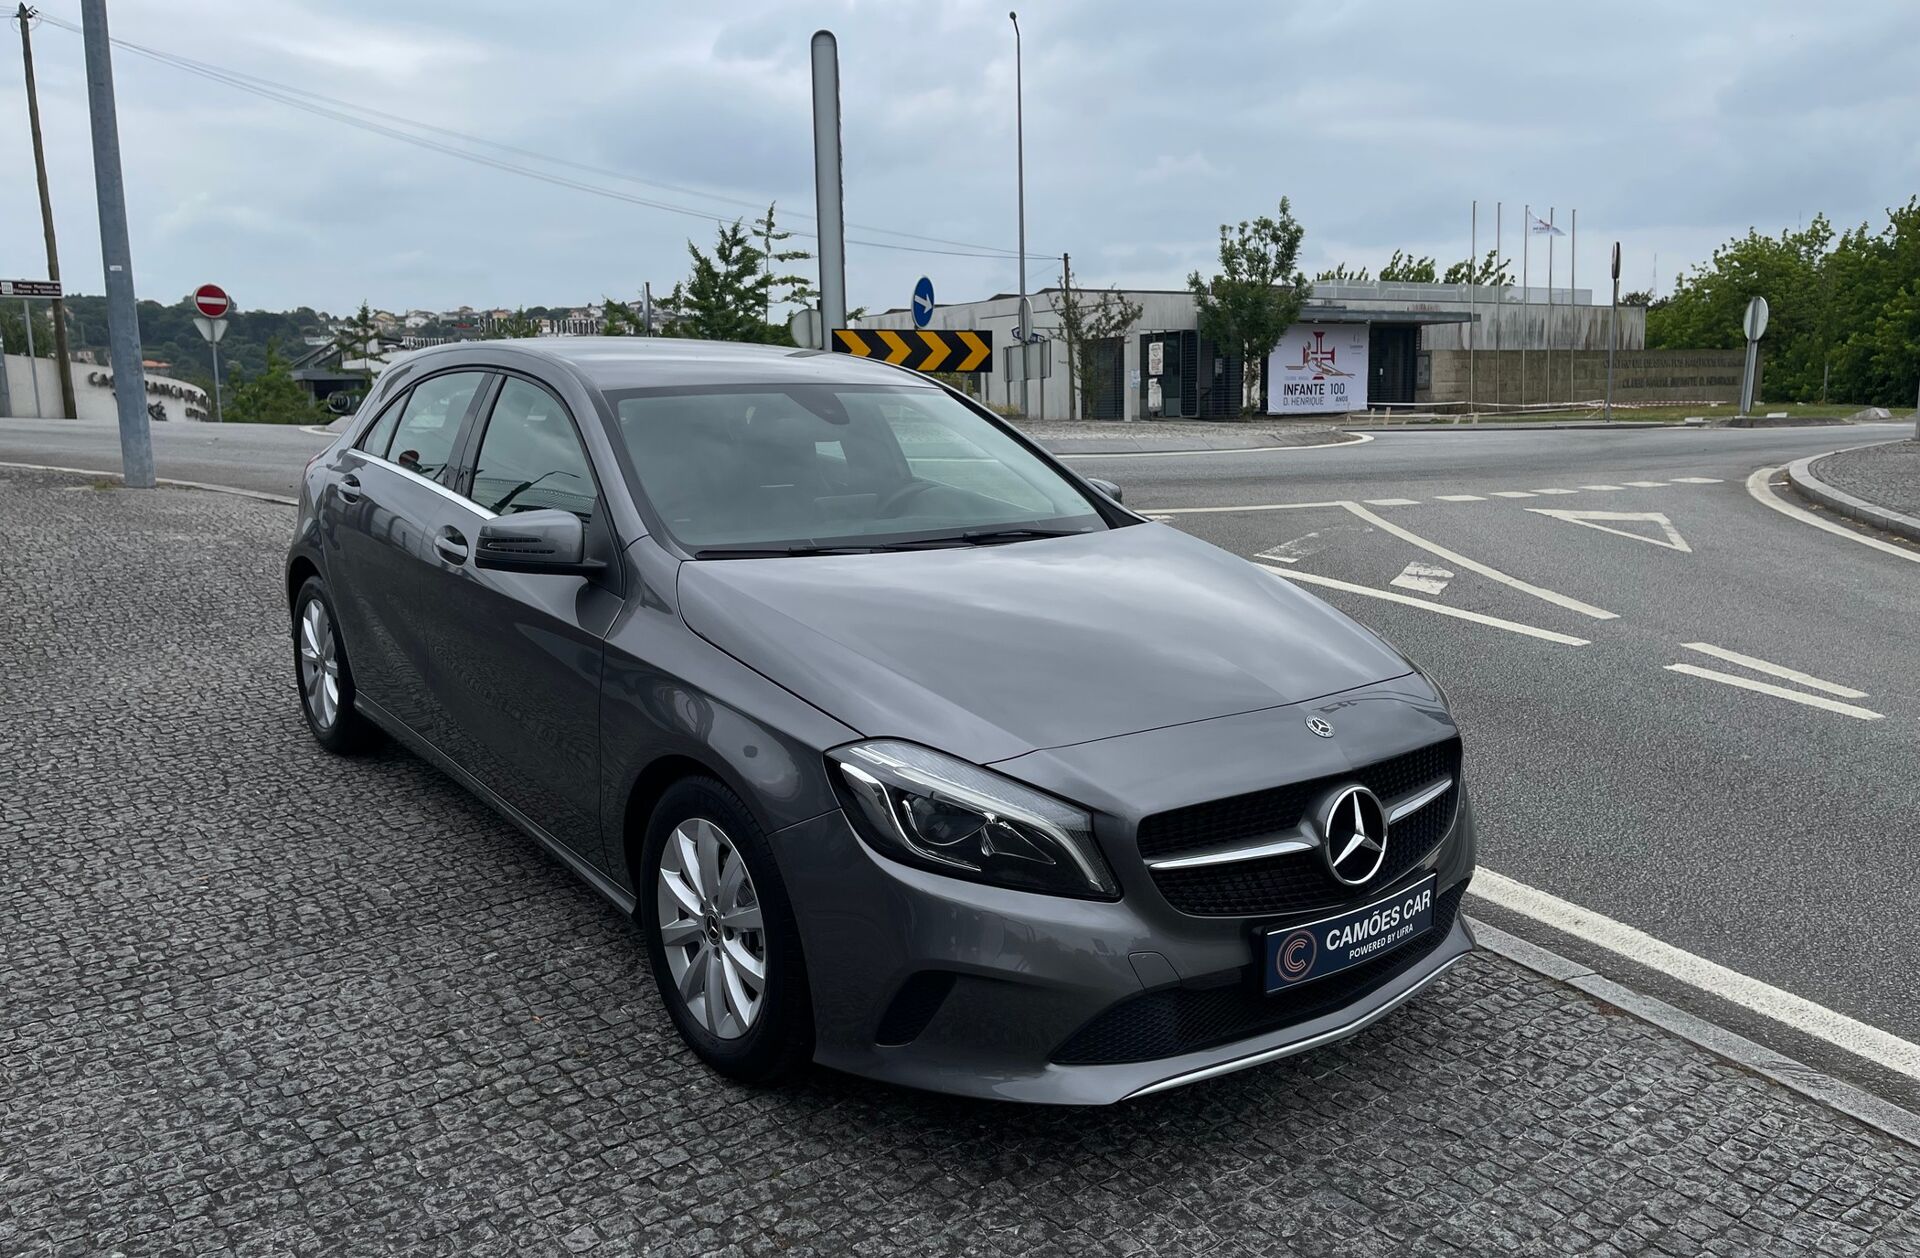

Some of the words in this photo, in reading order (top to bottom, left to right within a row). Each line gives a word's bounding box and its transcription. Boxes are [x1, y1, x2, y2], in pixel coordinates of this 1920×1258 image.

[1283, 383, 1325, 395] INFANTE
[1330, 383, 1345, 395] 100
[1283, 396, 1290, 406] D.
[1291, 396, 1325, 406] HENRIQUE
[1326, 905, 1401, 951] CAMÕES
[1403, 889, 1431, 920] CAR
[1349, 938, 1386, 960] POWERED
[1387, 931, 1398, 945] BY
